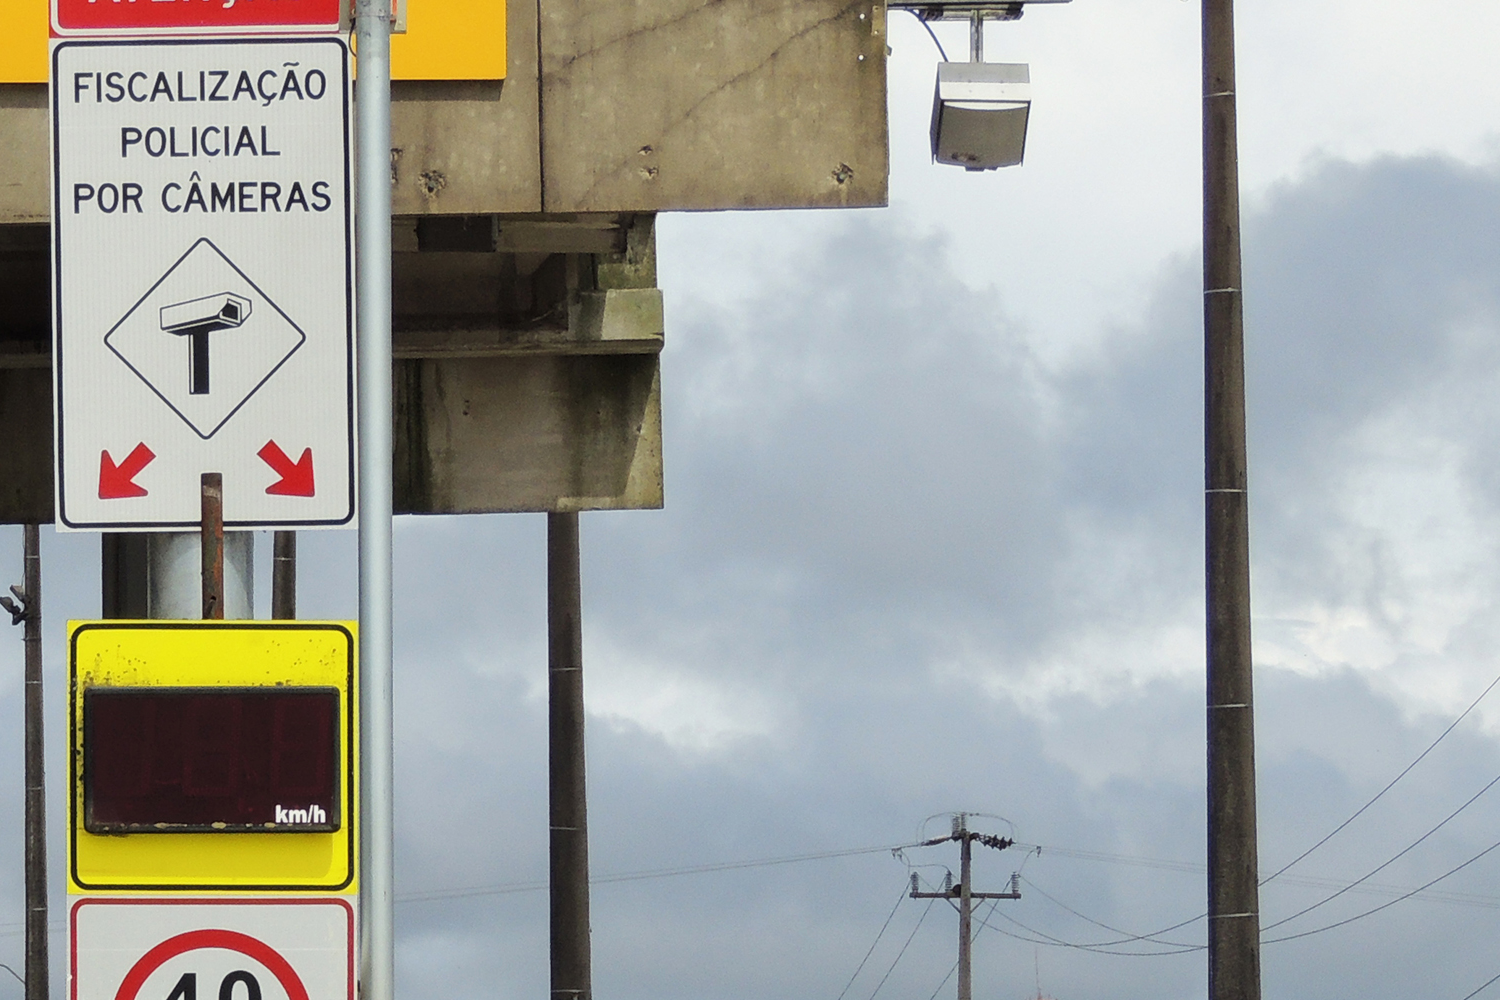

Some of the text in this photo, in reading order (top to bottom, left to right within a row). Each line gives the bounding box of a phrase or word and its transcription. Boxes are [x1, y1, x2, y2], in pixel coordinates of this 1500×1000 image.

[73, 61, 327, 107] FISCALIZAÇÃO
[121, 125, 281, 158] POLICIAL
[73, 171, 332, 214] POR CÂMERAS
[275, 804, 326, 825] km/h
